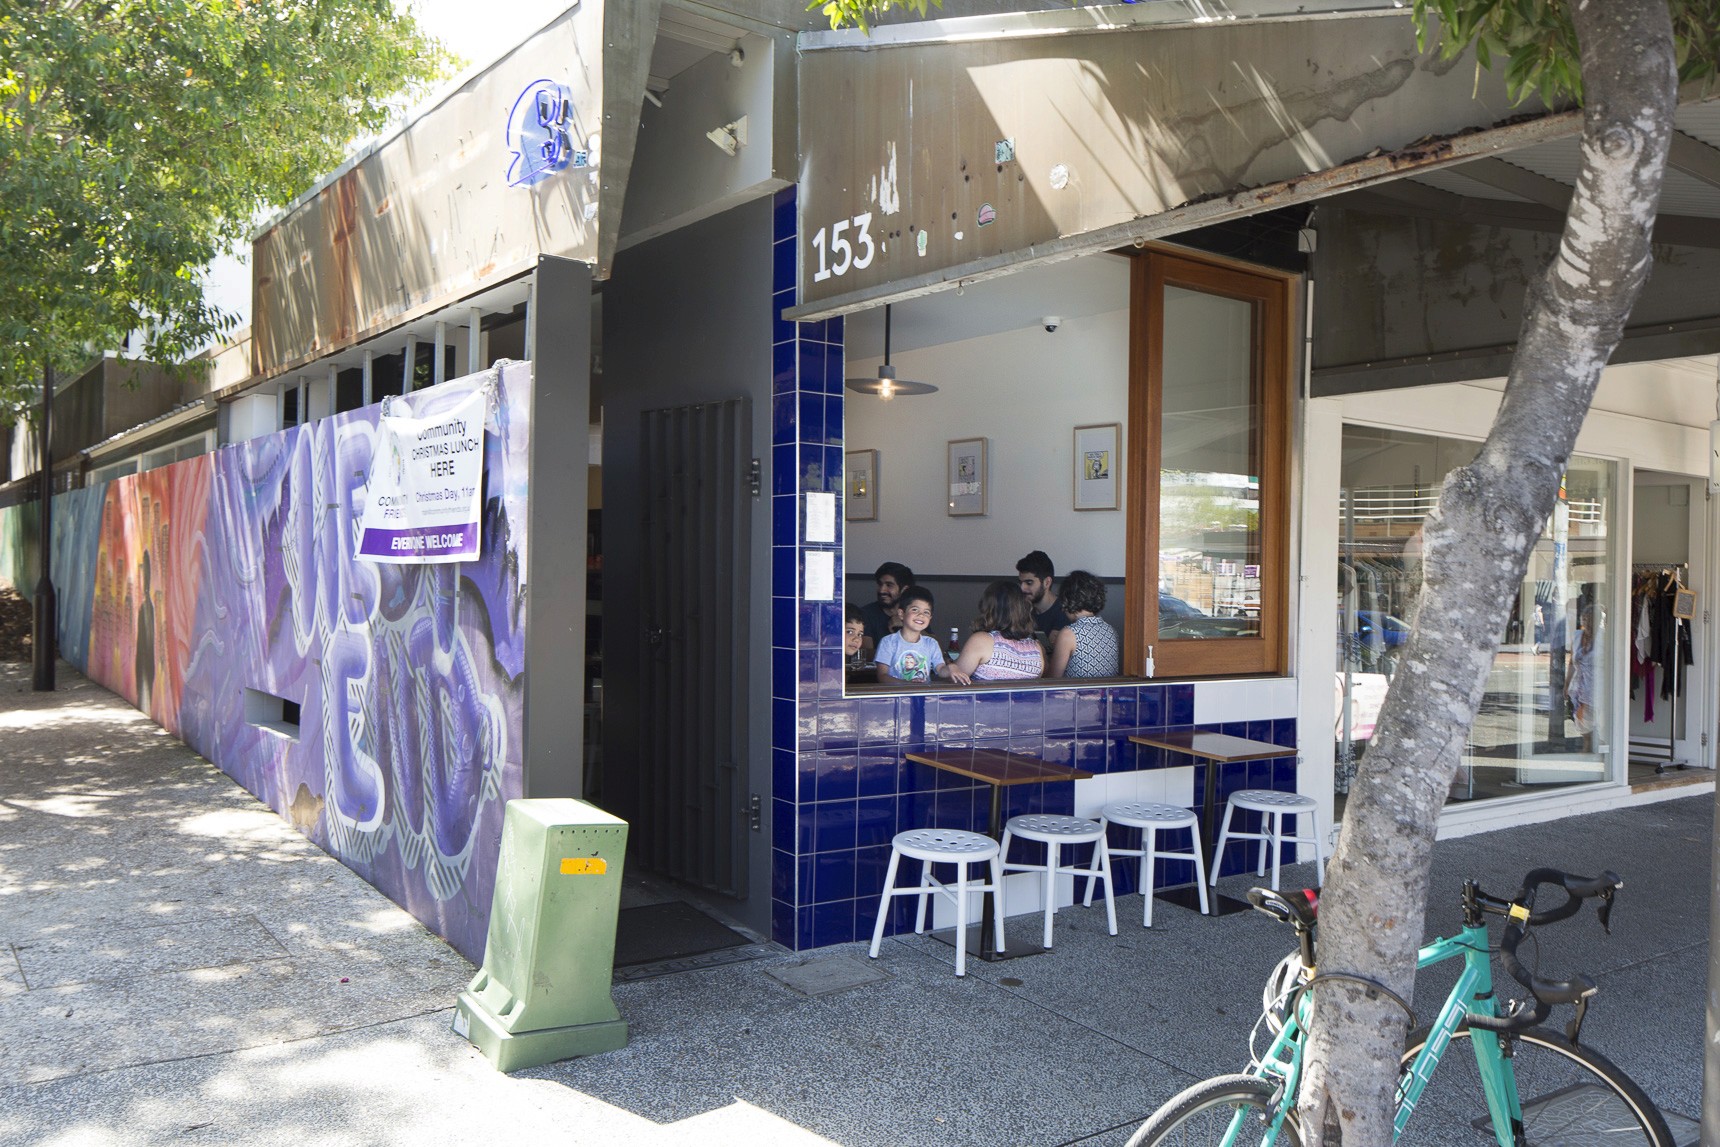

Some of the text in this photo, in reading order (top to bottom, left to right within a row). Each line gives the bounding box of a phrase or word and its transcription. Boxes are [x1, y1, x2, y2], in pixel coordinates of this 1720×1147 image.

[812, 212, 875, 283] 153
[411, 437, 479, 460] CHRISTMAS LUNCH
[430, 459, 455, 478] HERE
[415, 489, 443, 503] Christmas
[424, 532, 464, 549] WELCOME
